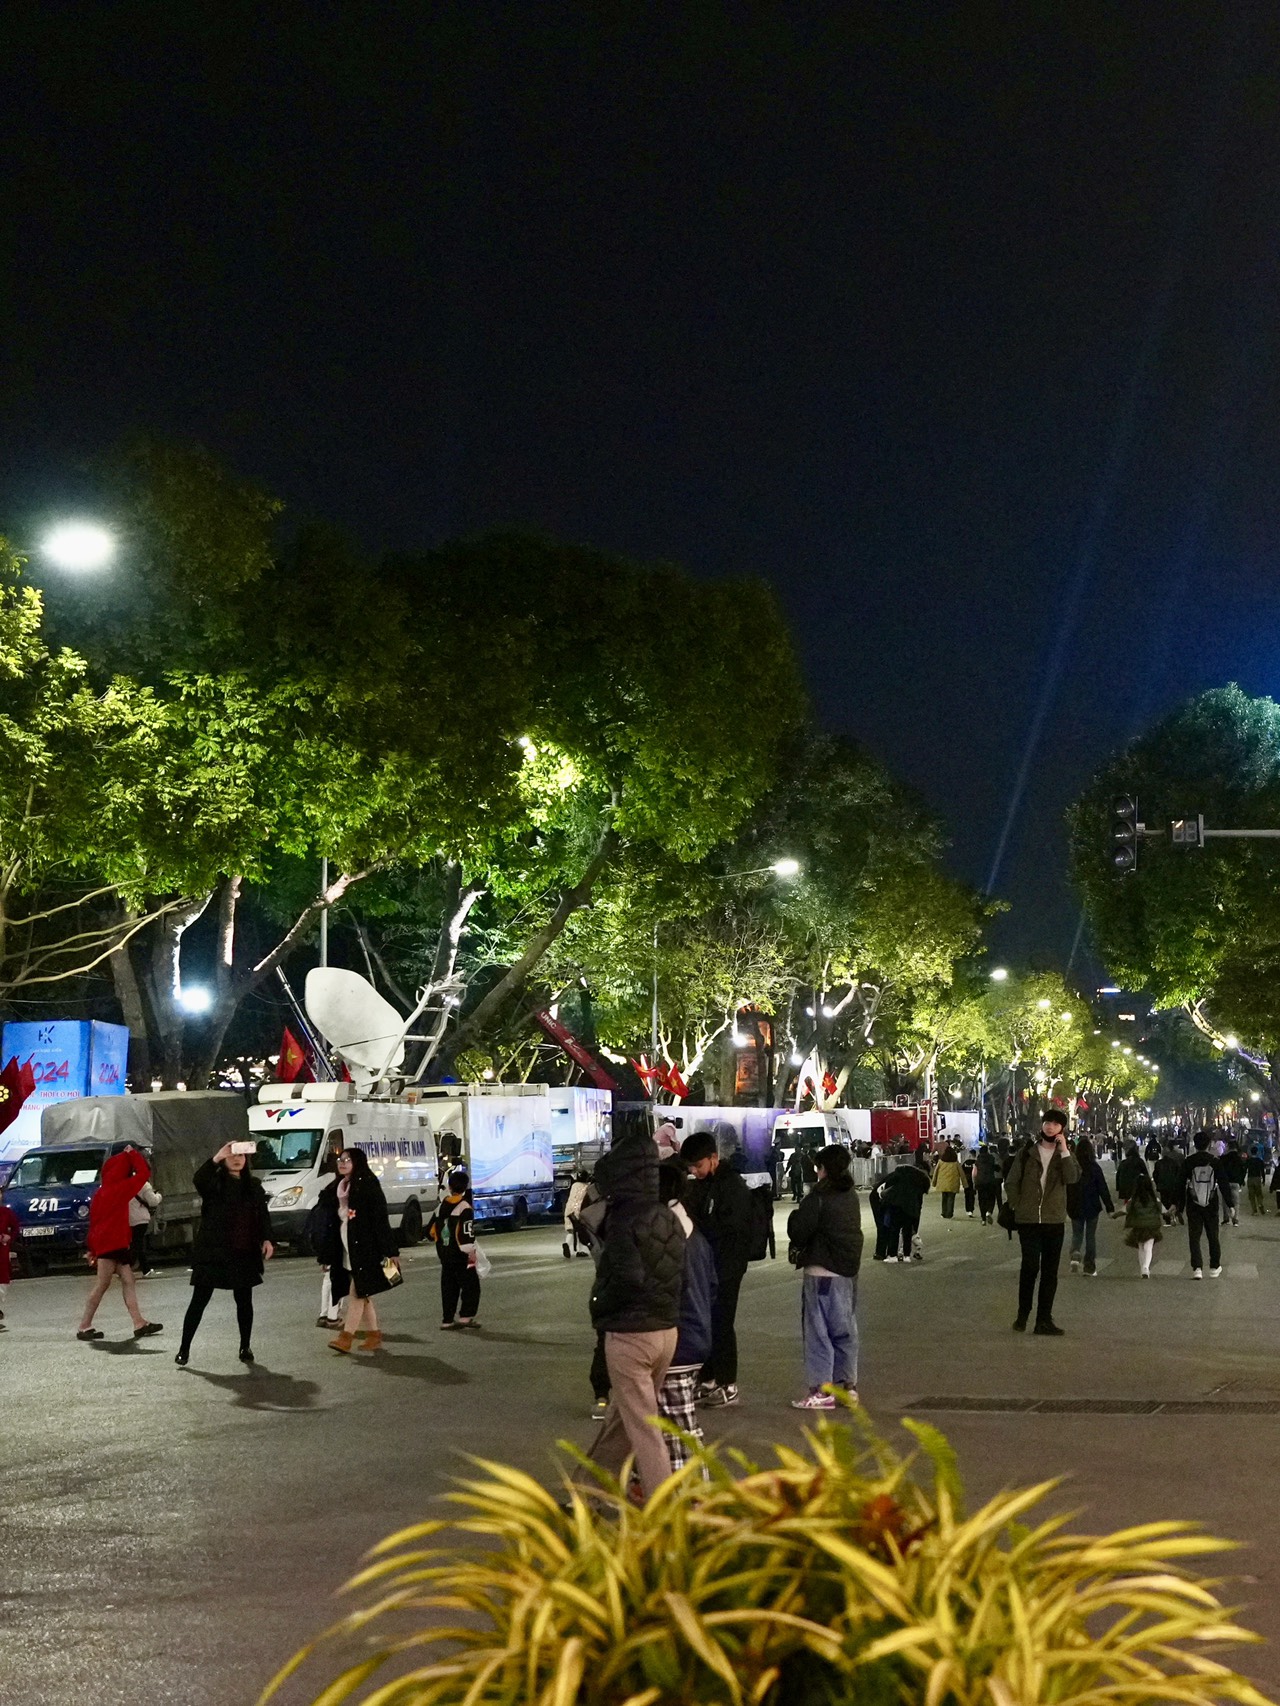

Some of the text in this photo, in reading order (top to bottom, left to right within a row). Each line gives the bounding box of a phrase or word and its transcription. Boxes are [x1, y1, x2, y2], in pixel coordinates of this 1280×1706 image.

[540, 1011, 557, 1029] UNIC
[33, 1060, 69, 1083] 024
[411, 1140, 426, 1157] NAM
